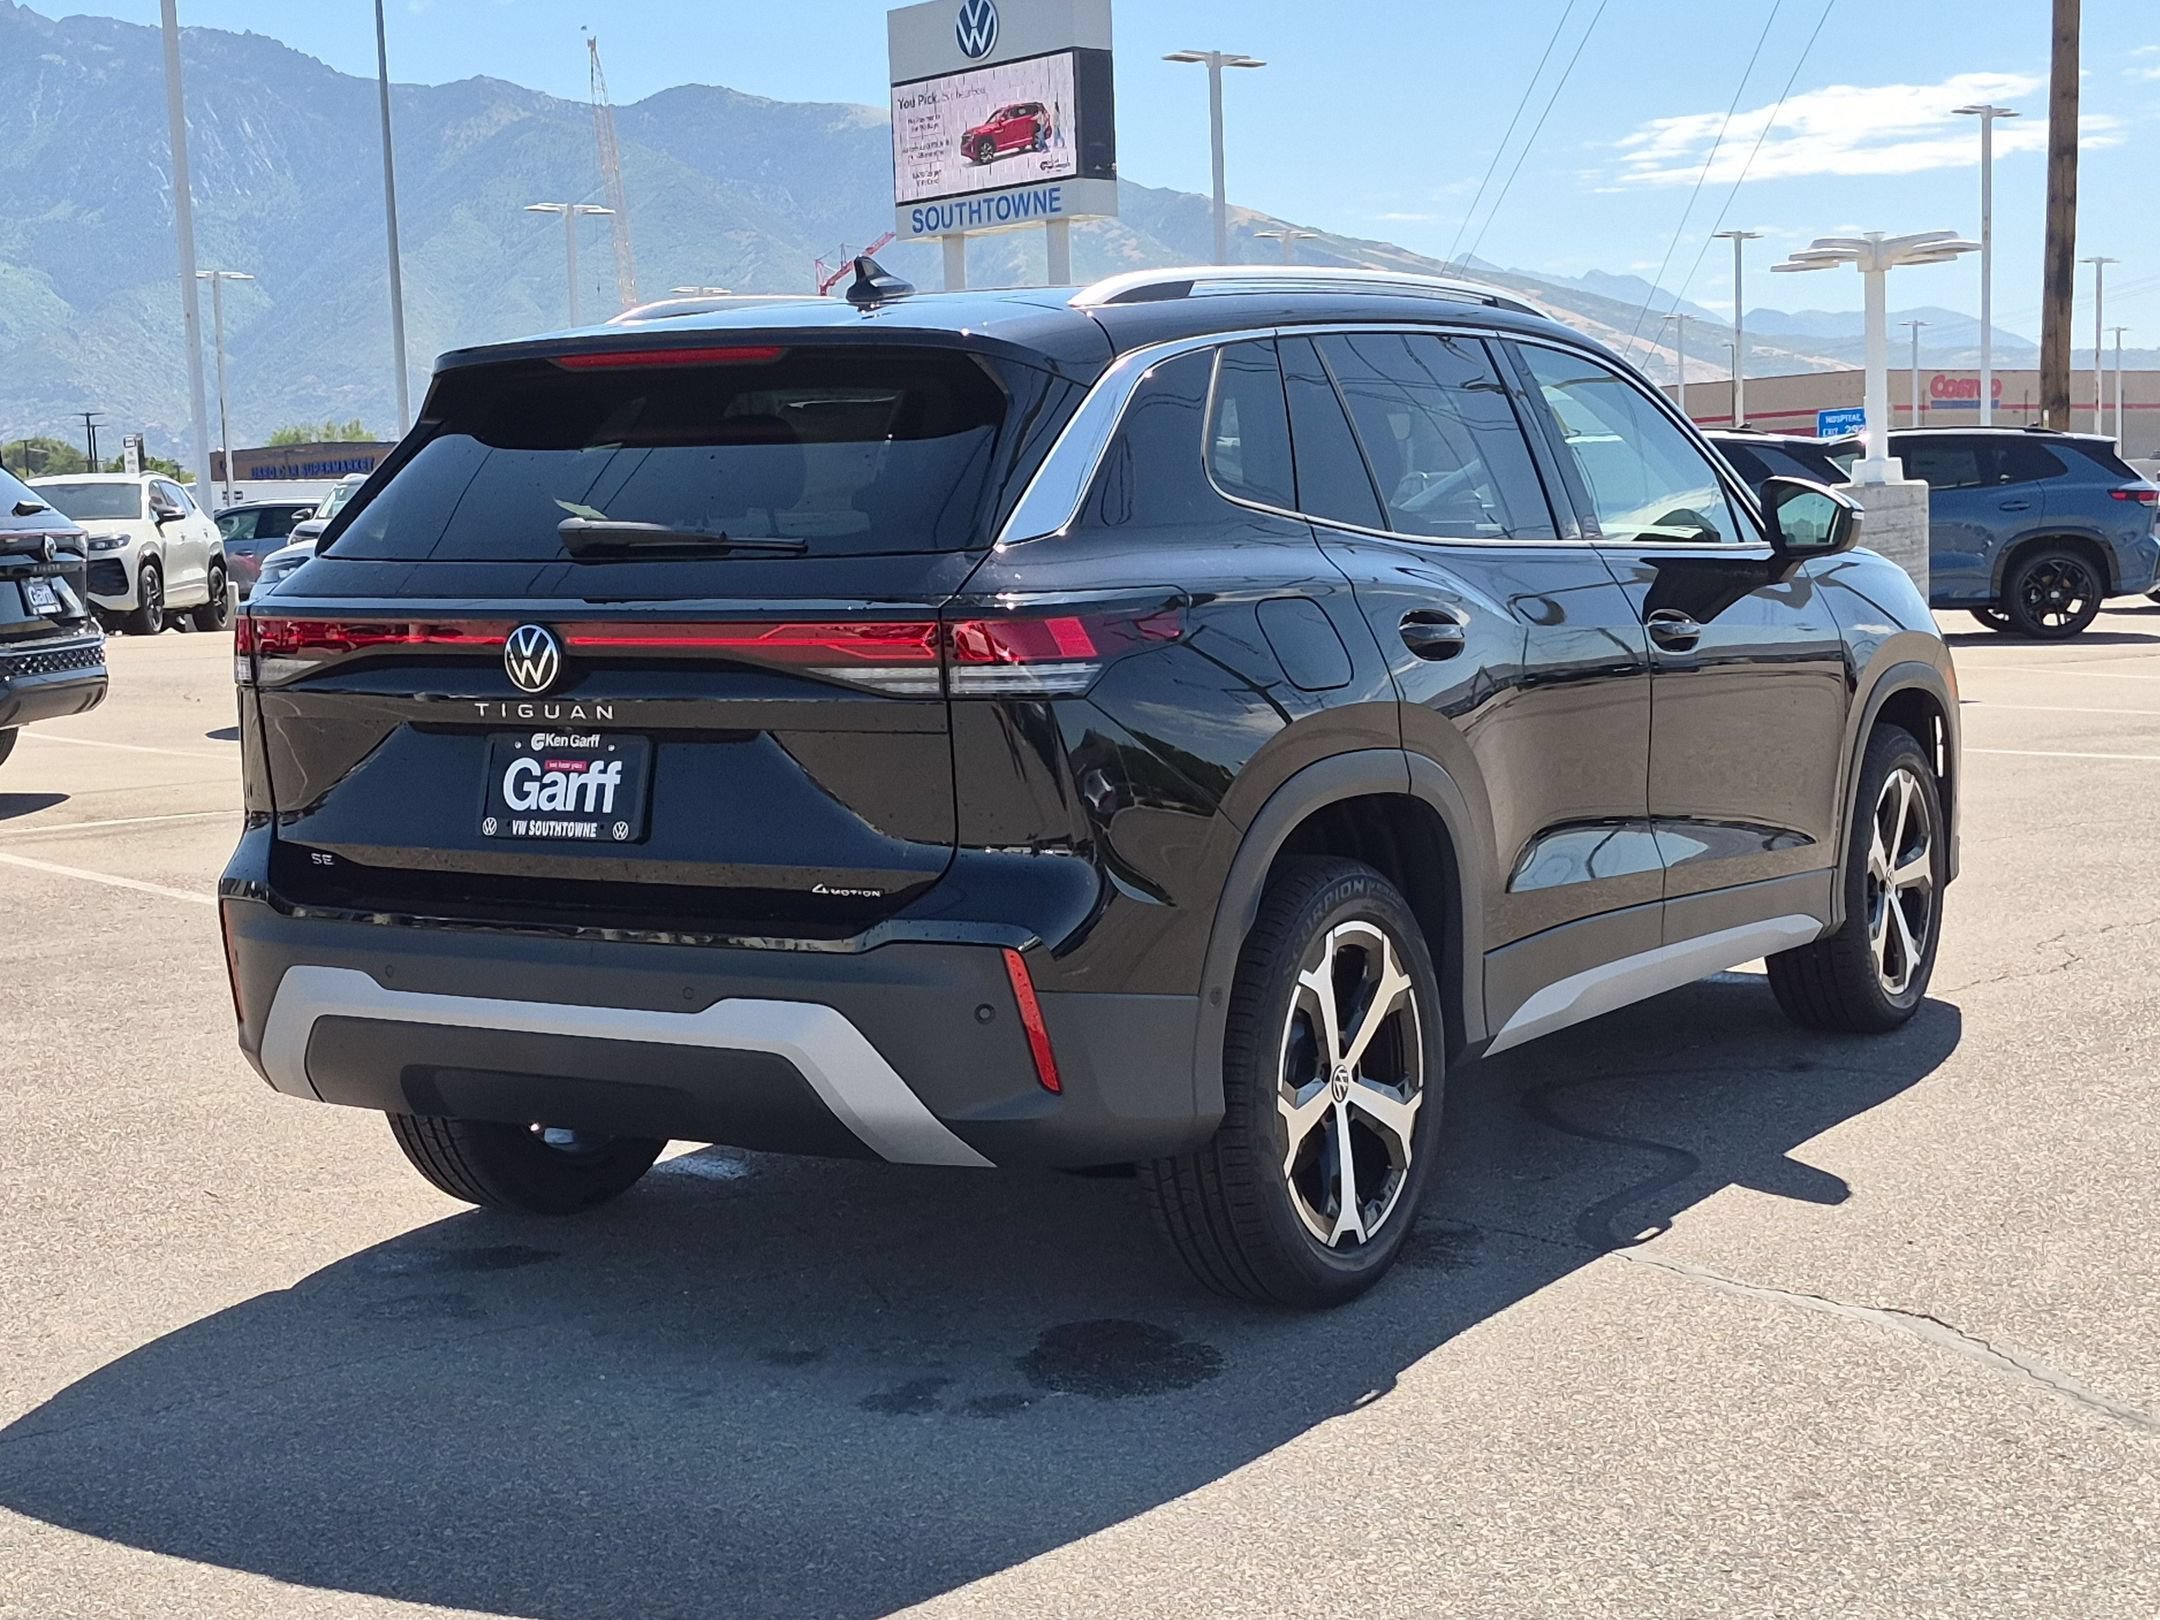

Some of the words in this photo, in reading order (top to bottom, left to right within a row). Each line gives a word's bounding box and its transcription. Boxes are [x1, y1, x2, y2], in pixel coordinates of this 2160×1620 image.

[897, 97, 916, 110] You
[918, 92, 937, 106] Pick
[912, 187, 1062, 233] SOUTHTOWNE
[1825, 413, 1863, 424] HOSPITAL
[1823, 428, 1838, 437] EXIT
[301, 457, 375, 477] SUPERMARKET
[474, 703, 614, 720] TIGUAN
[545, 733, 569, 747] Ken
[570, 734, 600, 748] Garff
[503, 757, 622, 814] Garff
[512, 820, 527, 835] VW
[529, 820, 598, 838] SOUTHTOWNE
[311, 852, 335, 866] SE
[811, 883, 881, 898] 4MOTION
